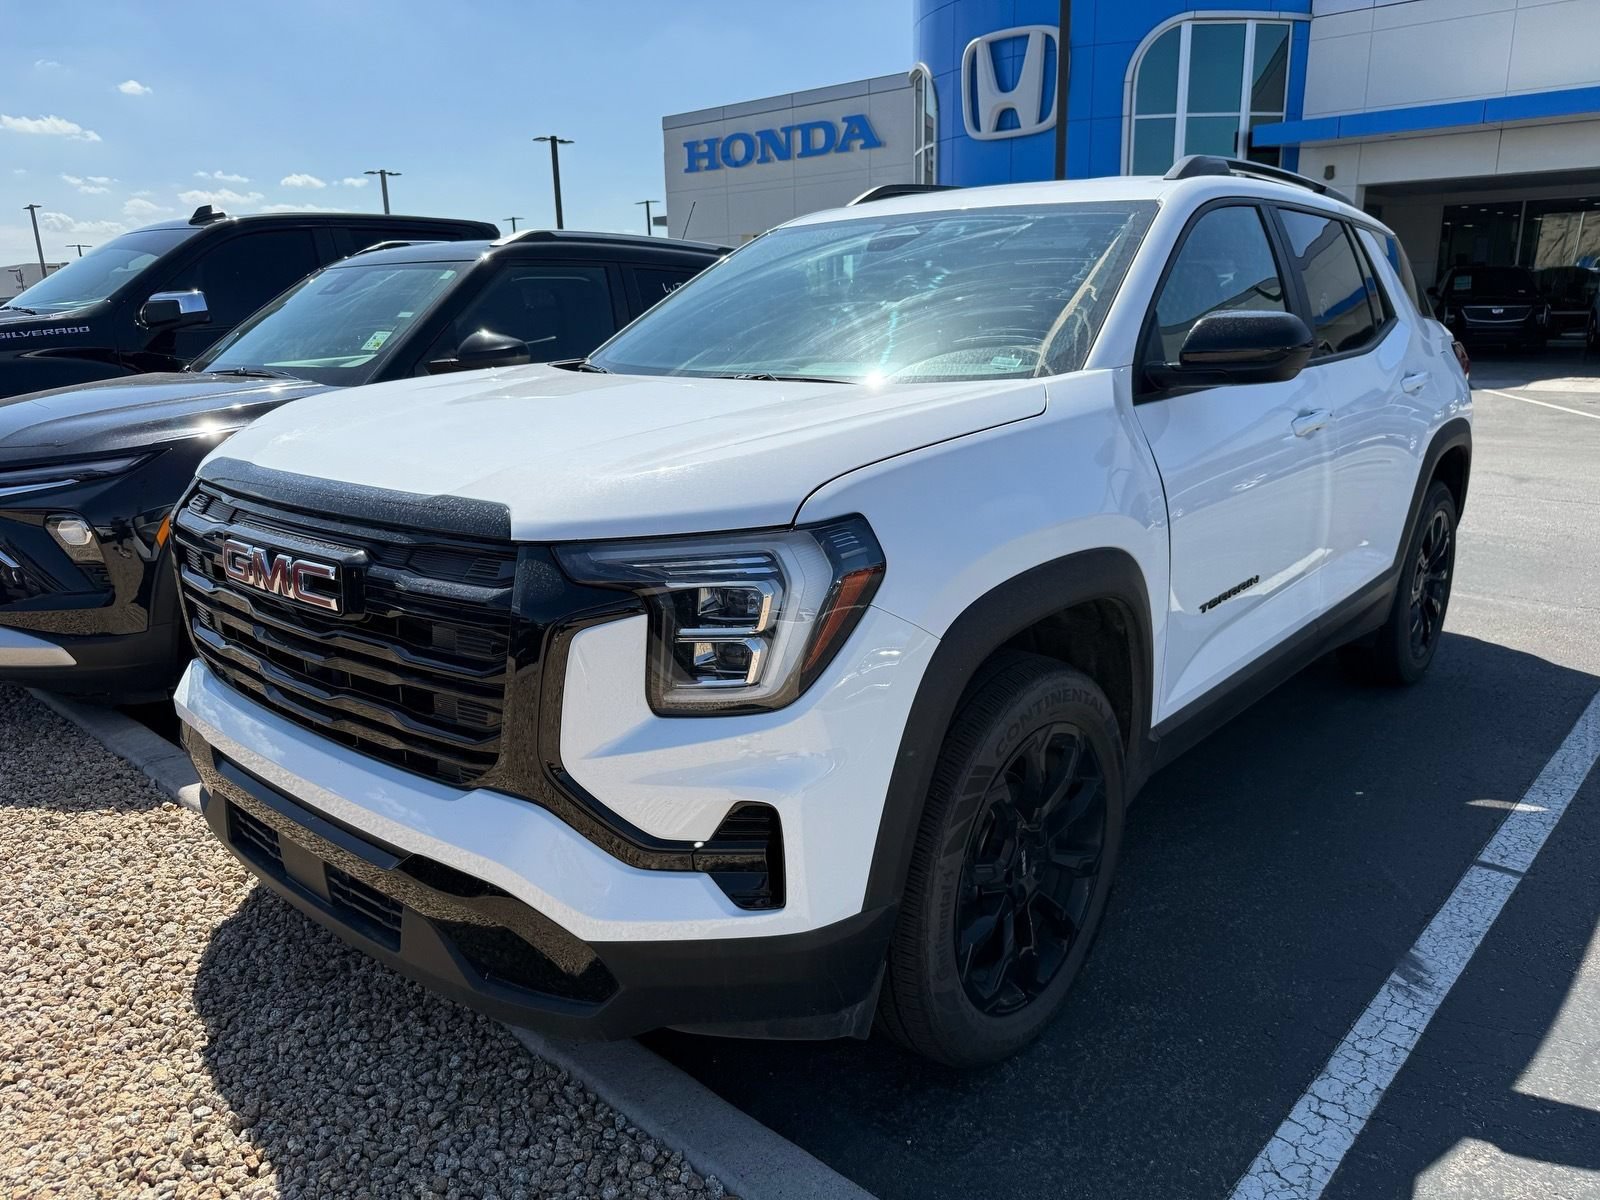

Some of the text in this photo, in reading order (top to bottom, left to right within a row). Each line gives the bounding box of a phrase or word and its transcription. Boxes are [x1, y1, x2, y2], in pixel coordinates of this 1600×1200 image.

[683, 113, 883, 174] HONDA
[222, 538, 339, 612] GMC
[1198, 574, 1260, 614] TERRAIN
[995, 687, 1106, 759] CONTINENTAL
